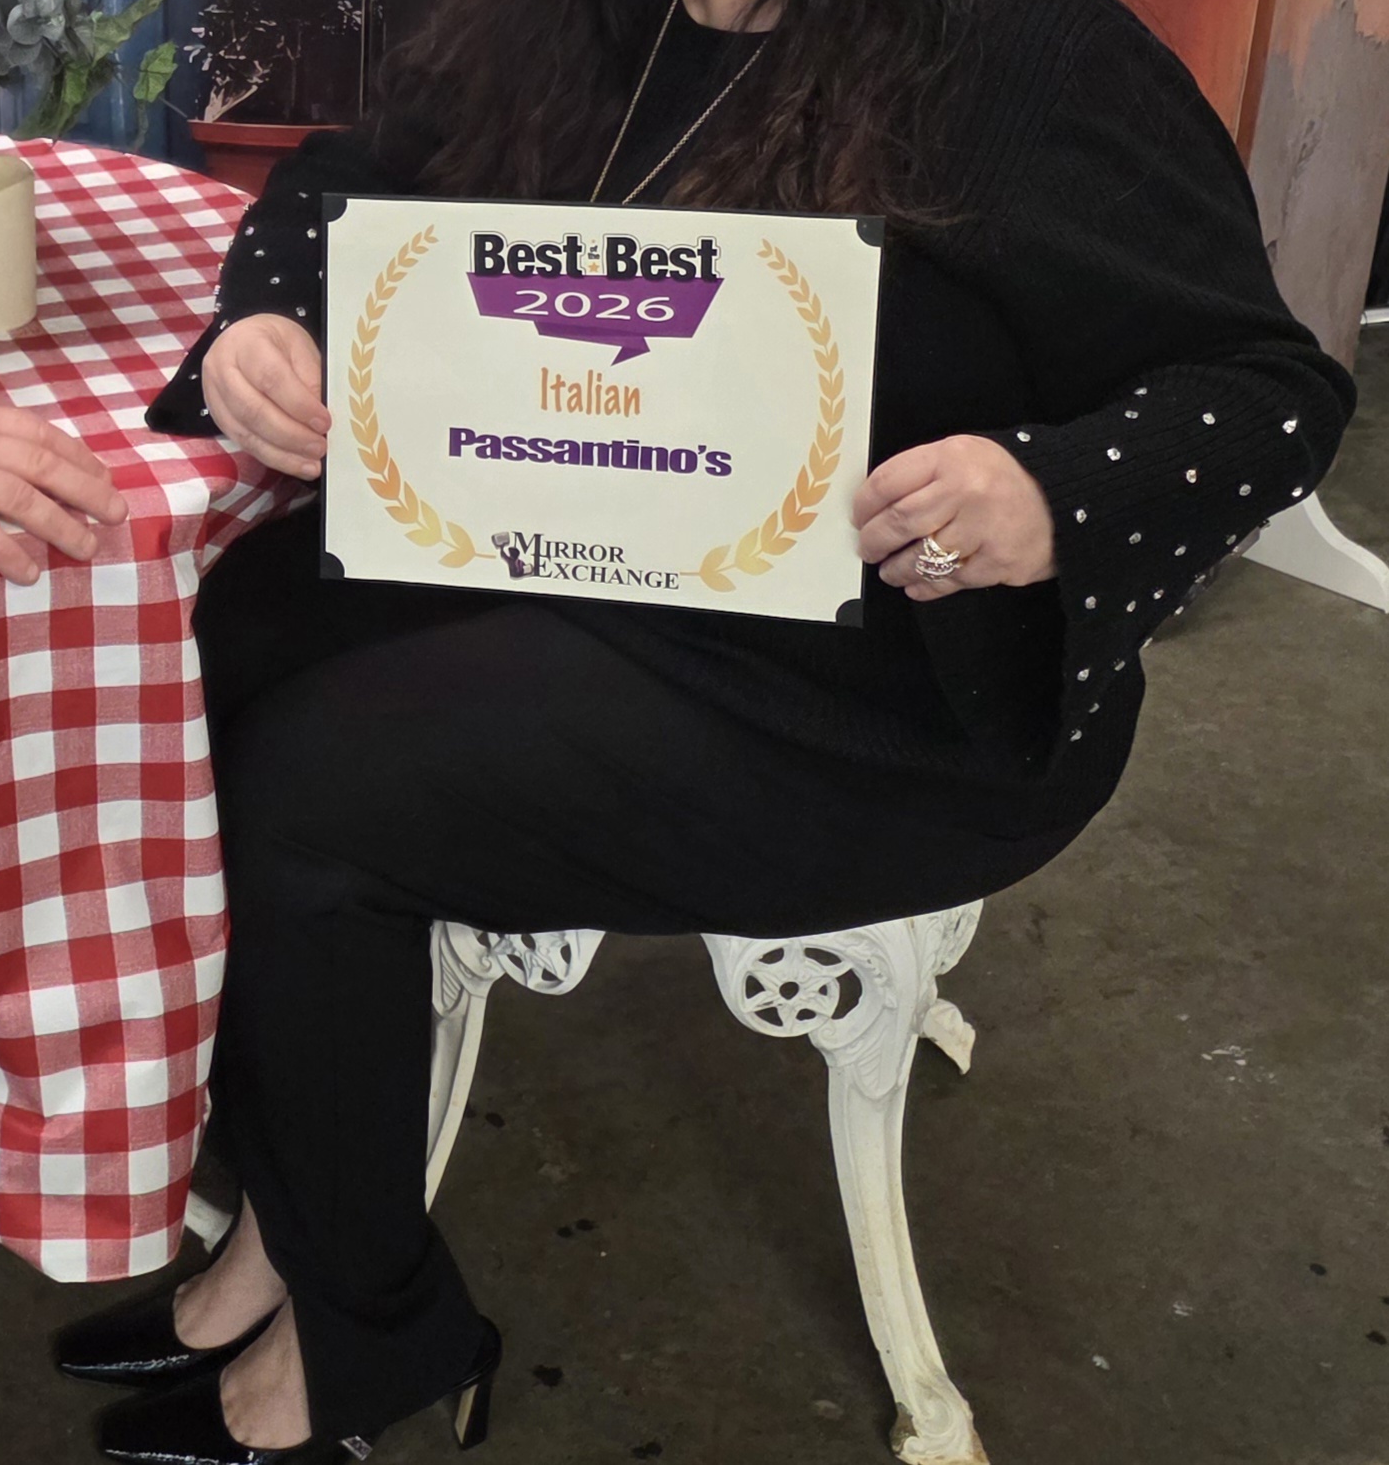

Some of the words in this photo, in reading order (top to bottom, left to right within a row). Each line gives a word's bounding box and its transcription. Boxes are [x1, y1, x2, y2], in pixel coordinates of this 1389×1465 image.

[473, 233, 585, 278] Best
[587, 252, 600, 260] the
[589, 245, 598, 253] of
[606, 235, 719, 283] Best
[513, 289, 675, 322] 2026
[540, 366, 641, 418] Italian
[448, 426, 733, 477] Passantino's
[511, 530, 626, 564] MIRROR
[531, 552, 680, 591] EXCHANGE
